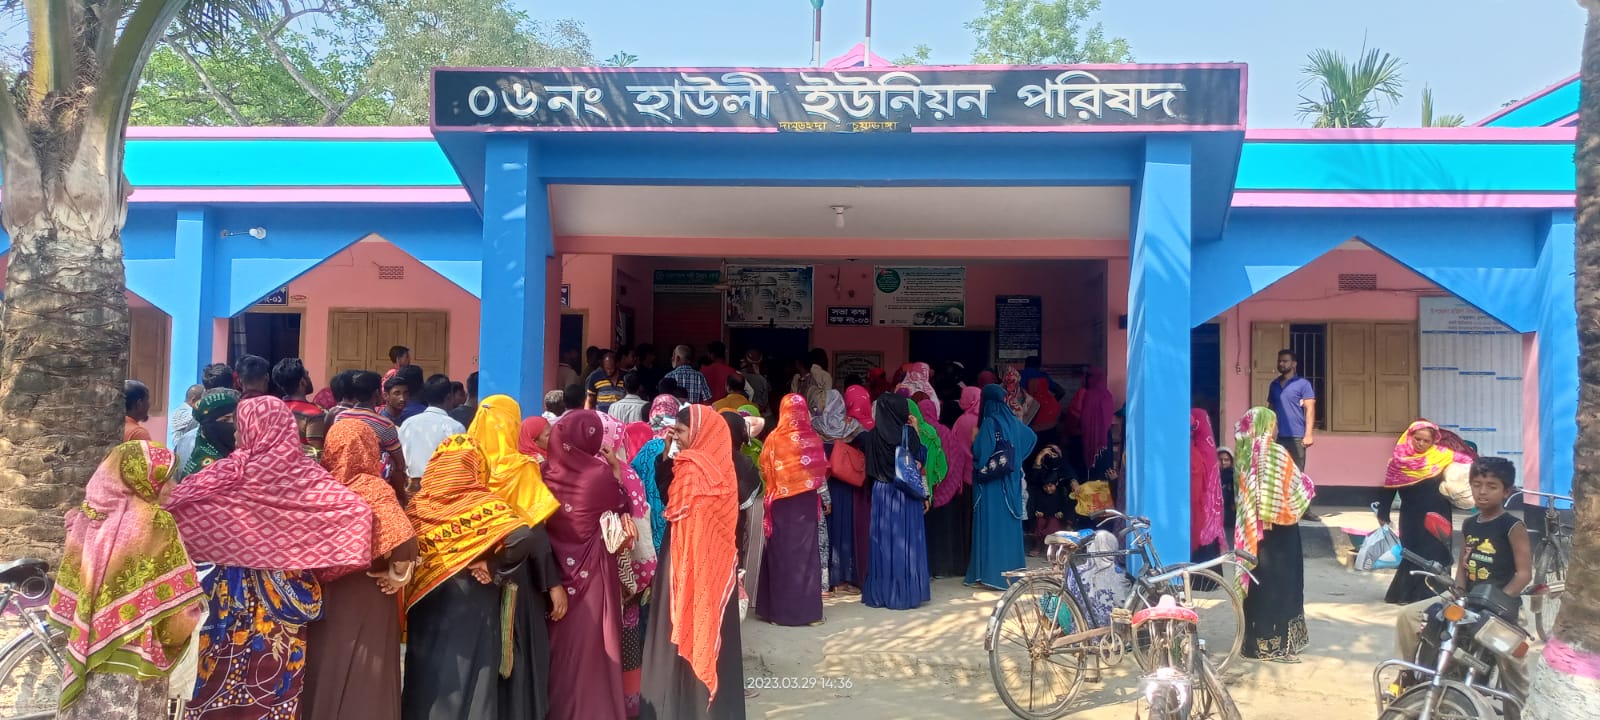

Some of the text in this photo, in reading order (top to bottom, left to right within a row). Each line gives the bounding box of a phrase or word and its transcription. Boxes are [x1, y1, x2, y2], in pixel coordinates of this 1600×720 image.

[625, 72, 779, 123] হাউলী
[795, 71, 995, 122] ইউনিয়ন
[1017, 71, 1187, 120] পরিষদ
